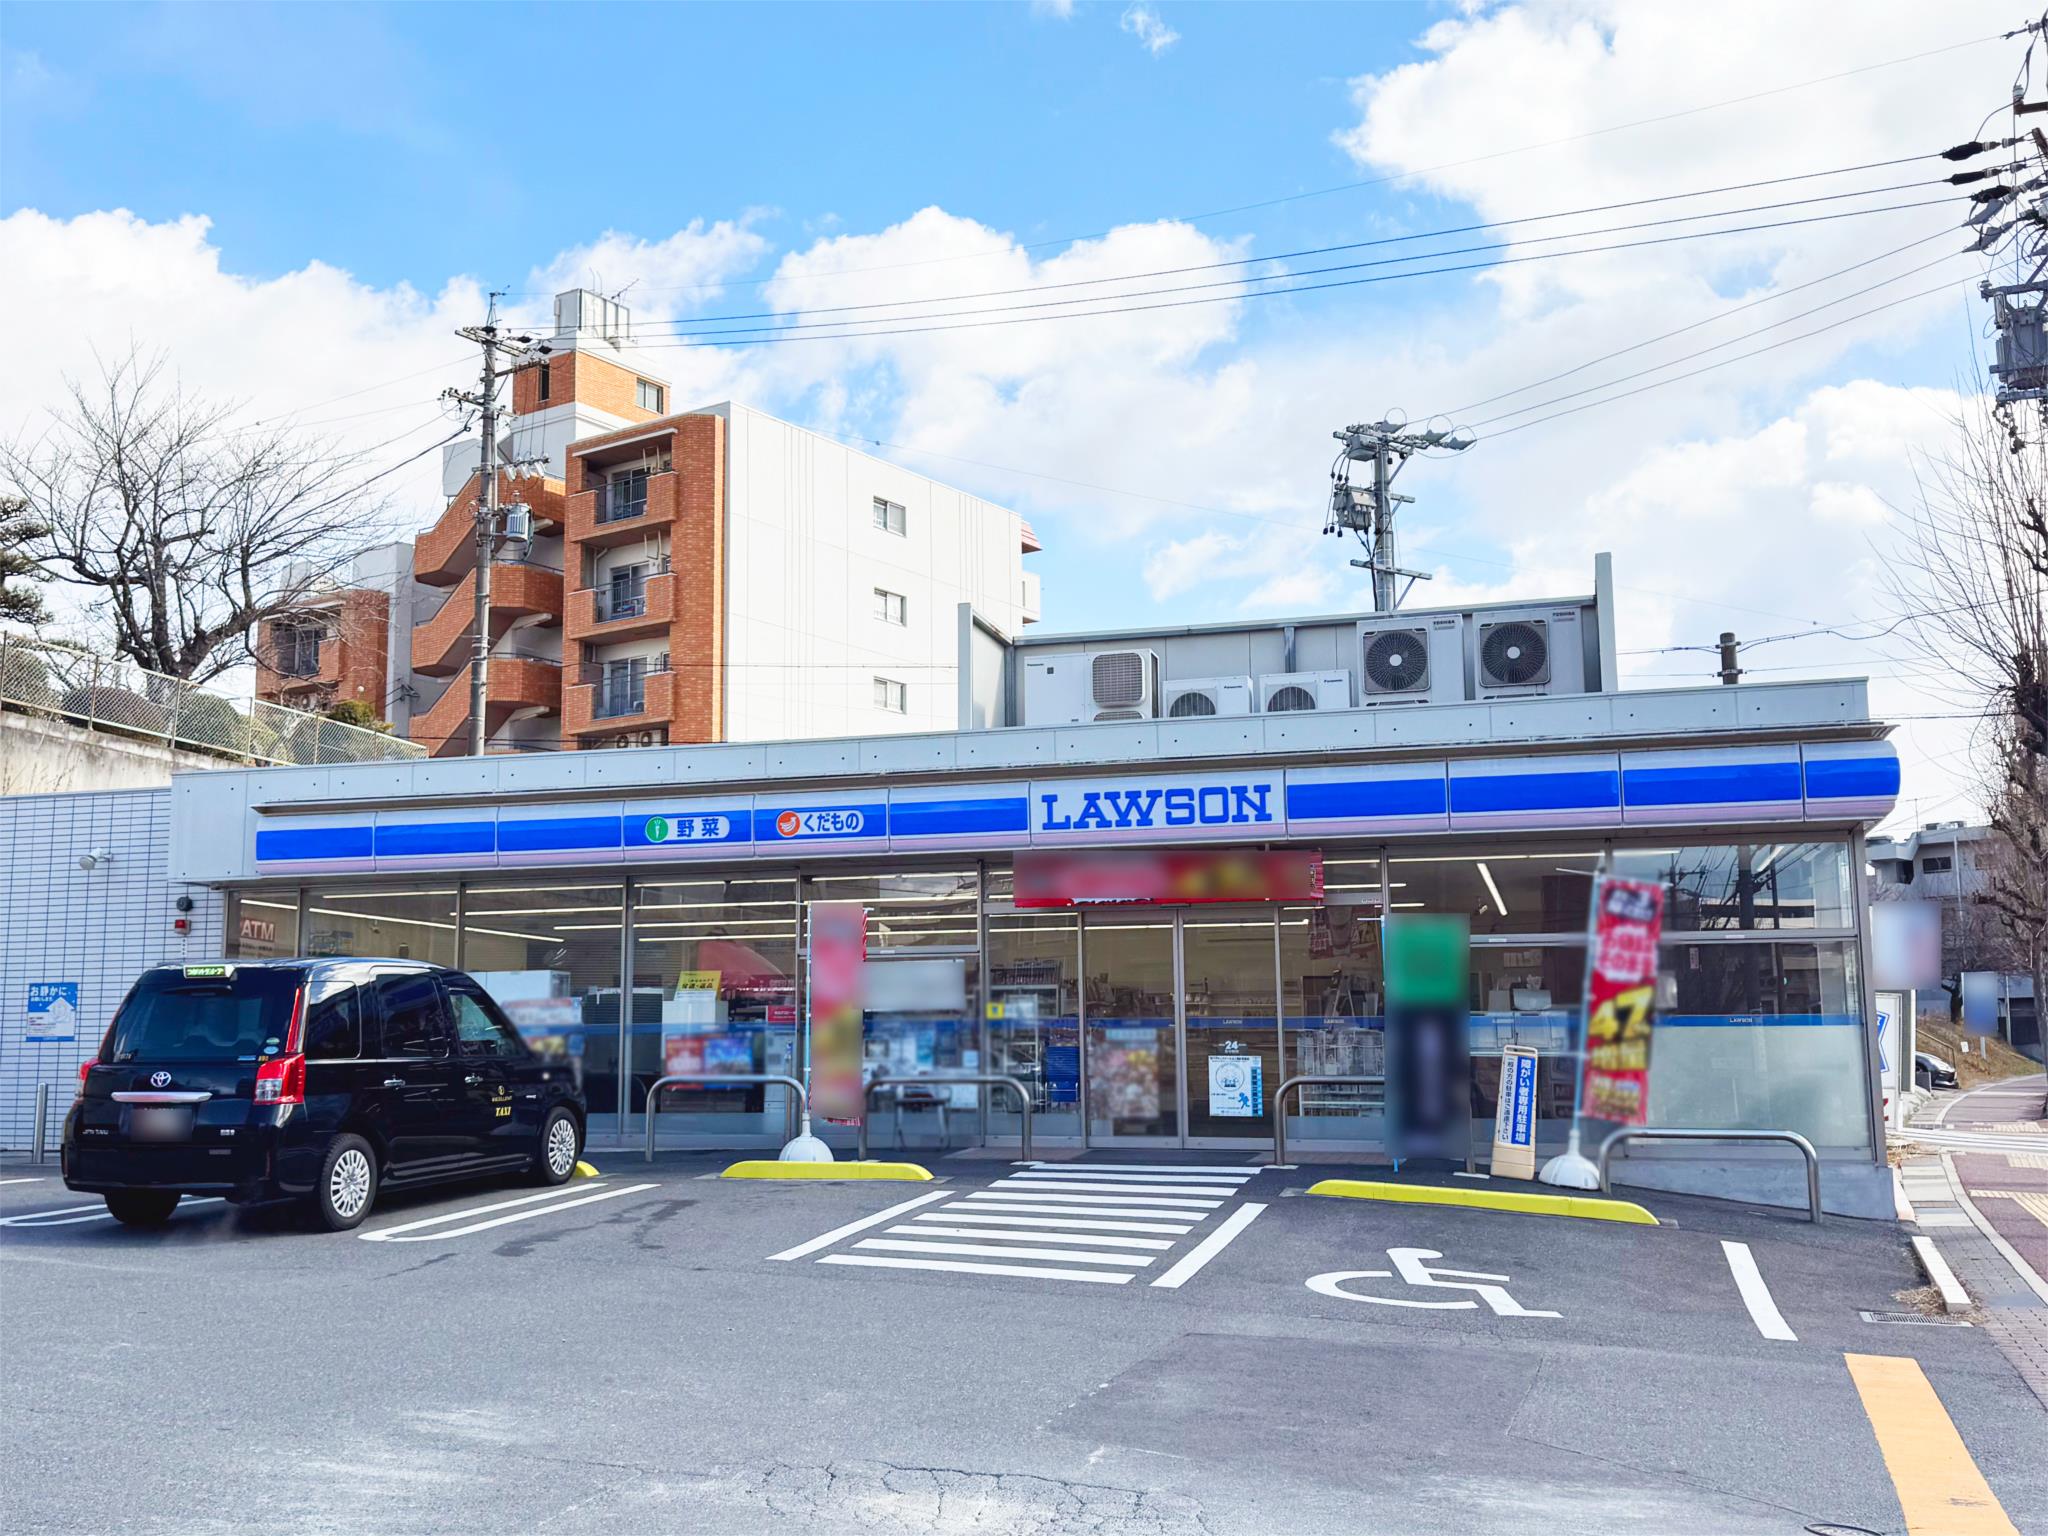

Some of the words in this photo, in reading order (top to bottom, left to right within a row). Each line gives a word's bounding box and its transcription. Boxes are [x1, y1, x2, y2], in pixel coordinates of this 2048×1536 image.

[1041, 784, 1272, 831] LAWSON
[677, 817, 720, 838] 野菜
[803, 812, 860, 833] くだもの
[241, 919, 274, 941] ATM
[1225, 1040, 1239, 1050] 24
[495, 1106, 512, 1117] TAXI
